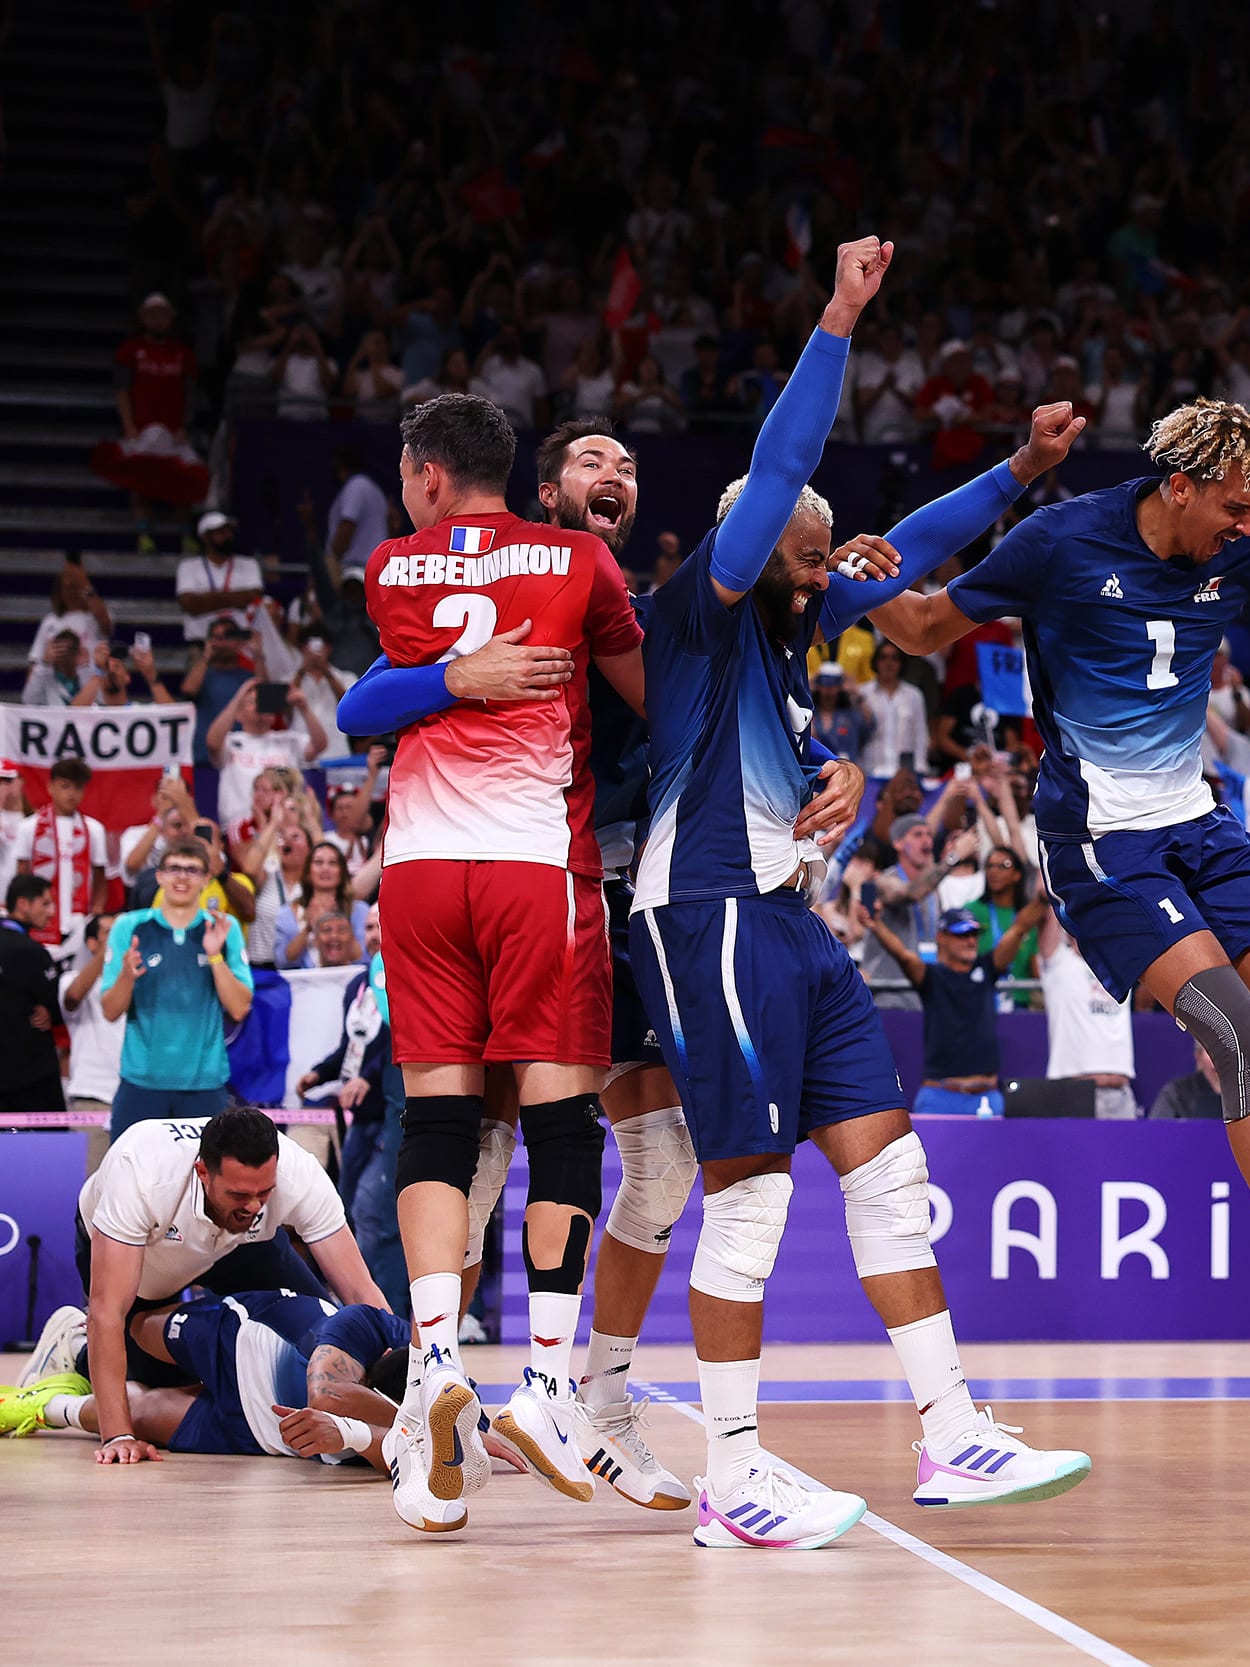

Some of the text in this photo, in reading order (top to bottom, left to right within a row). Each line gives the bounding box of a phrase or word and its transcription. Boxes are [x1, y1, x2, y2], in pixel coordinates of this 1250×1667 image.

[1193, 591, 1221, 603] FRA
[433, 593, 498, 664] 2
[1146, 620, 1180, 690] 1
[20, 717, 189, 761] RACOT
[1157, 897, 1185, 924] 1
[768, 1102, 780, 1134] 9
